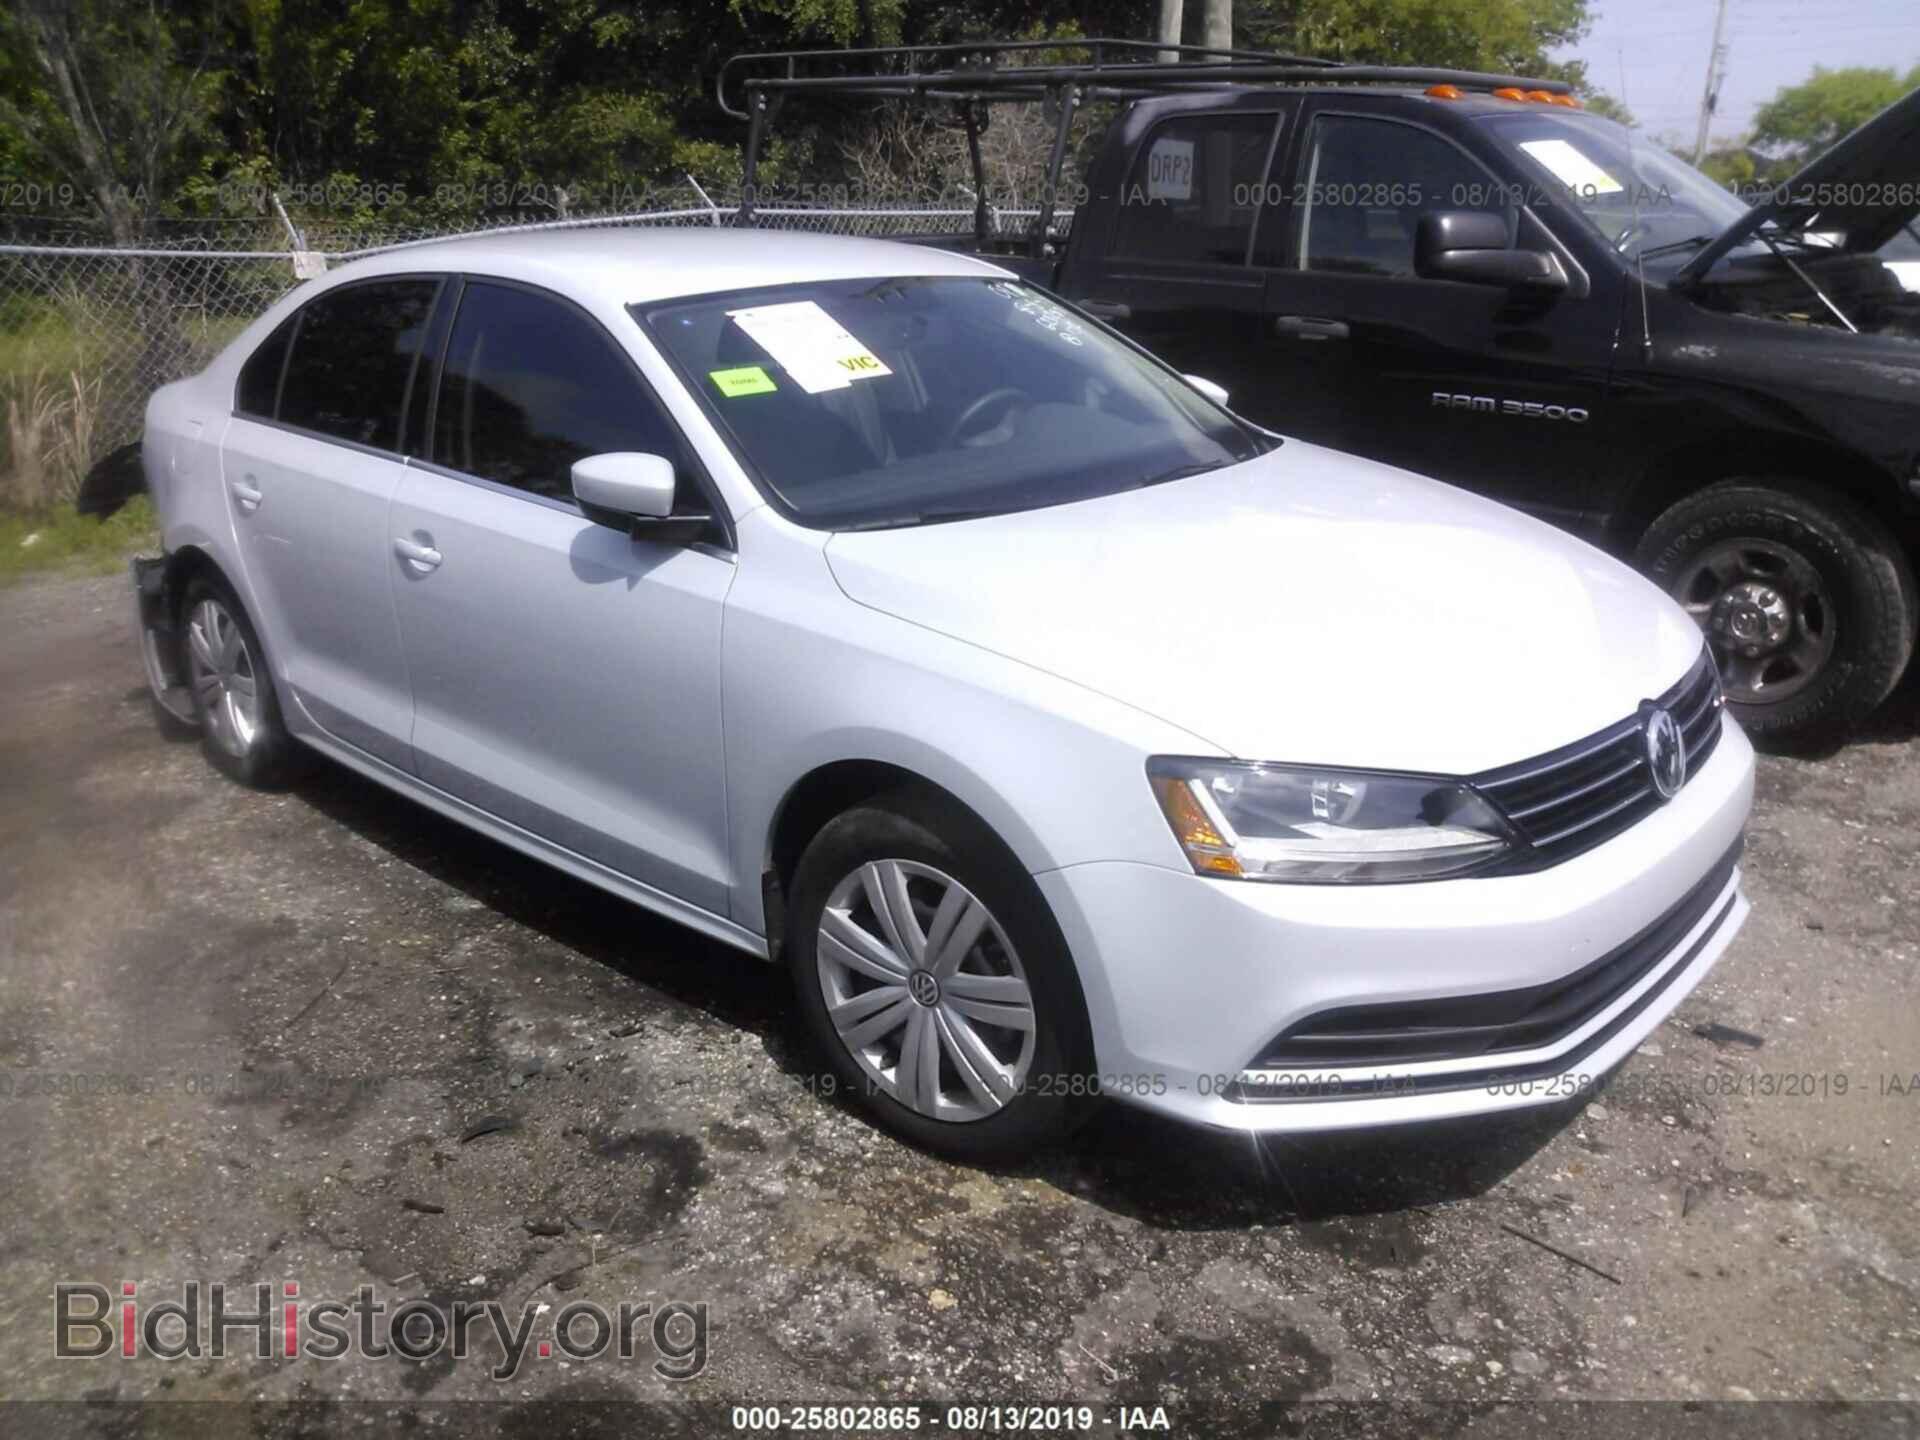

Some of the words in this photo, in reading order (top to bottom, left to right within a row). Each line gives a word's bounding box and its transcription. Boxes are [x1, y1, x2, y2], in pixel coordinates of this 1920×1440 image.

[835, 355, 880, 373] VIC
[1431, 391, 1497, 415] RAM
[1501, 399, 1590, 424] 3500
